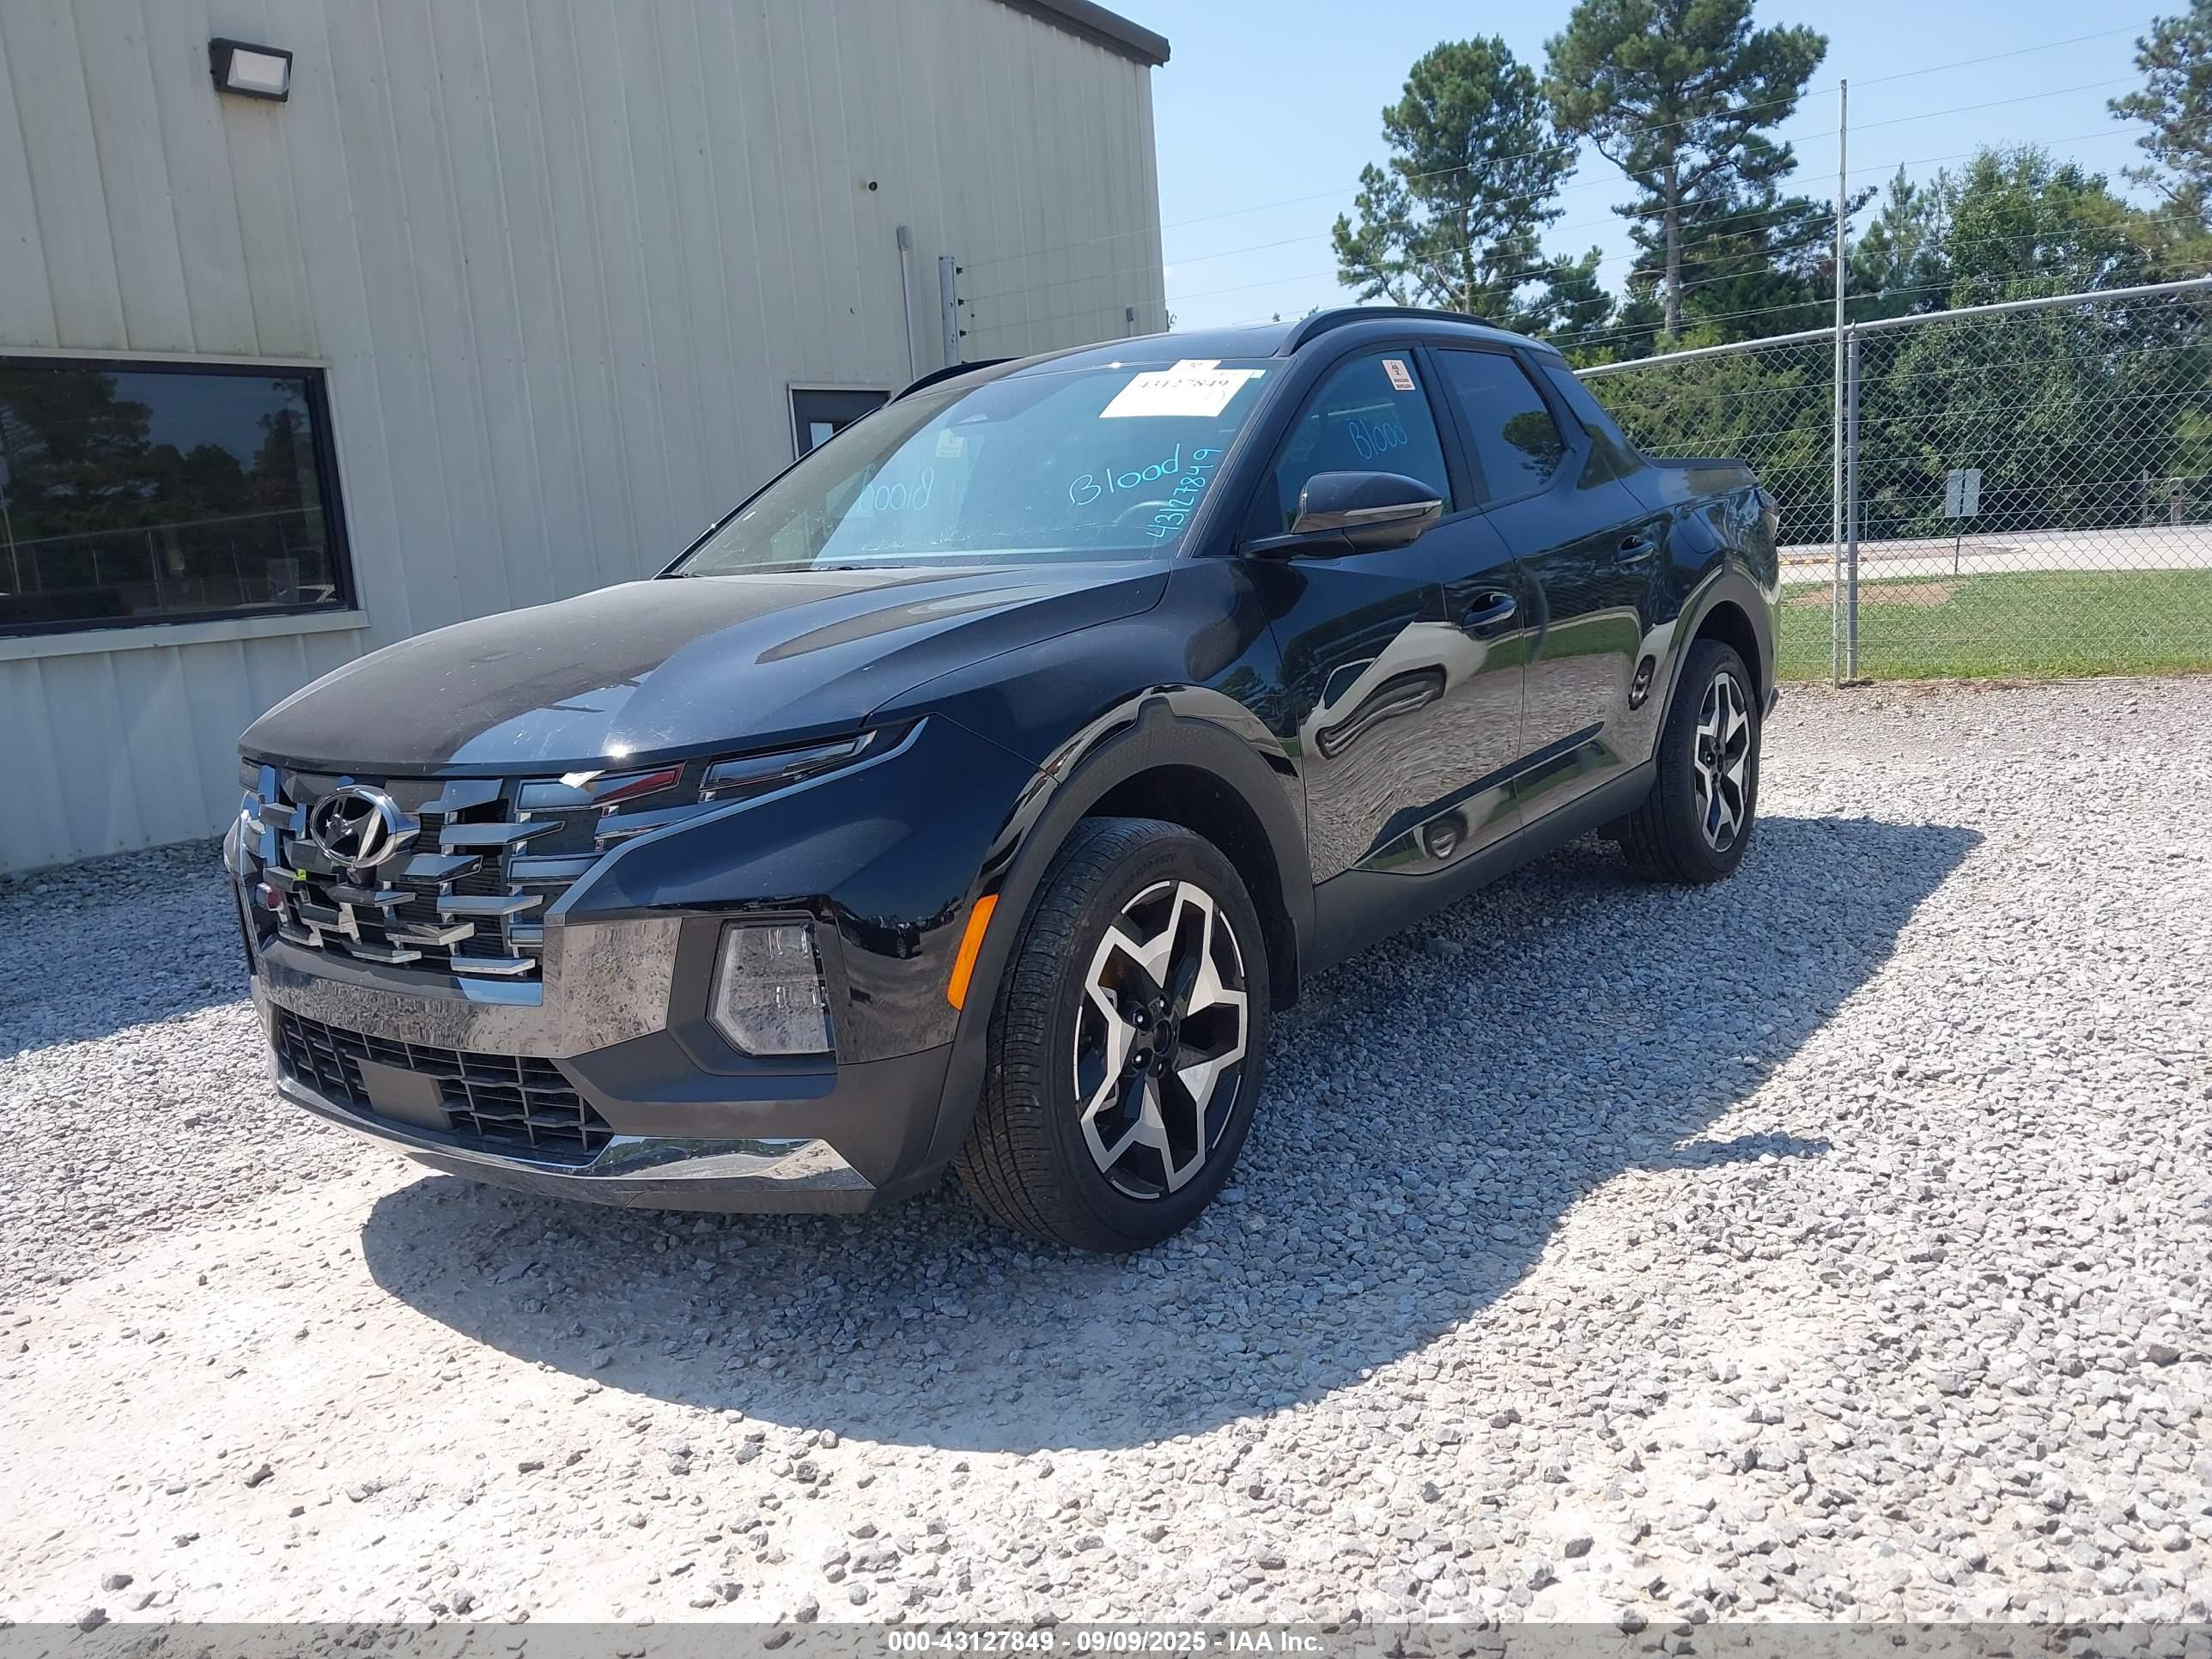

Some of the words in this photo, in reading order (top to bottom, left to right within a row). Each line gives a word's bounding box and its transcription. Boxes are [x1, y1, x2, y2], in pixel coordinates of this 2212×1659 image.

[1348, 417, 1407, 459] Blood
[1069, 443, 1181, 506] Blood
[1146, 447, 1224, 538] 43127849
